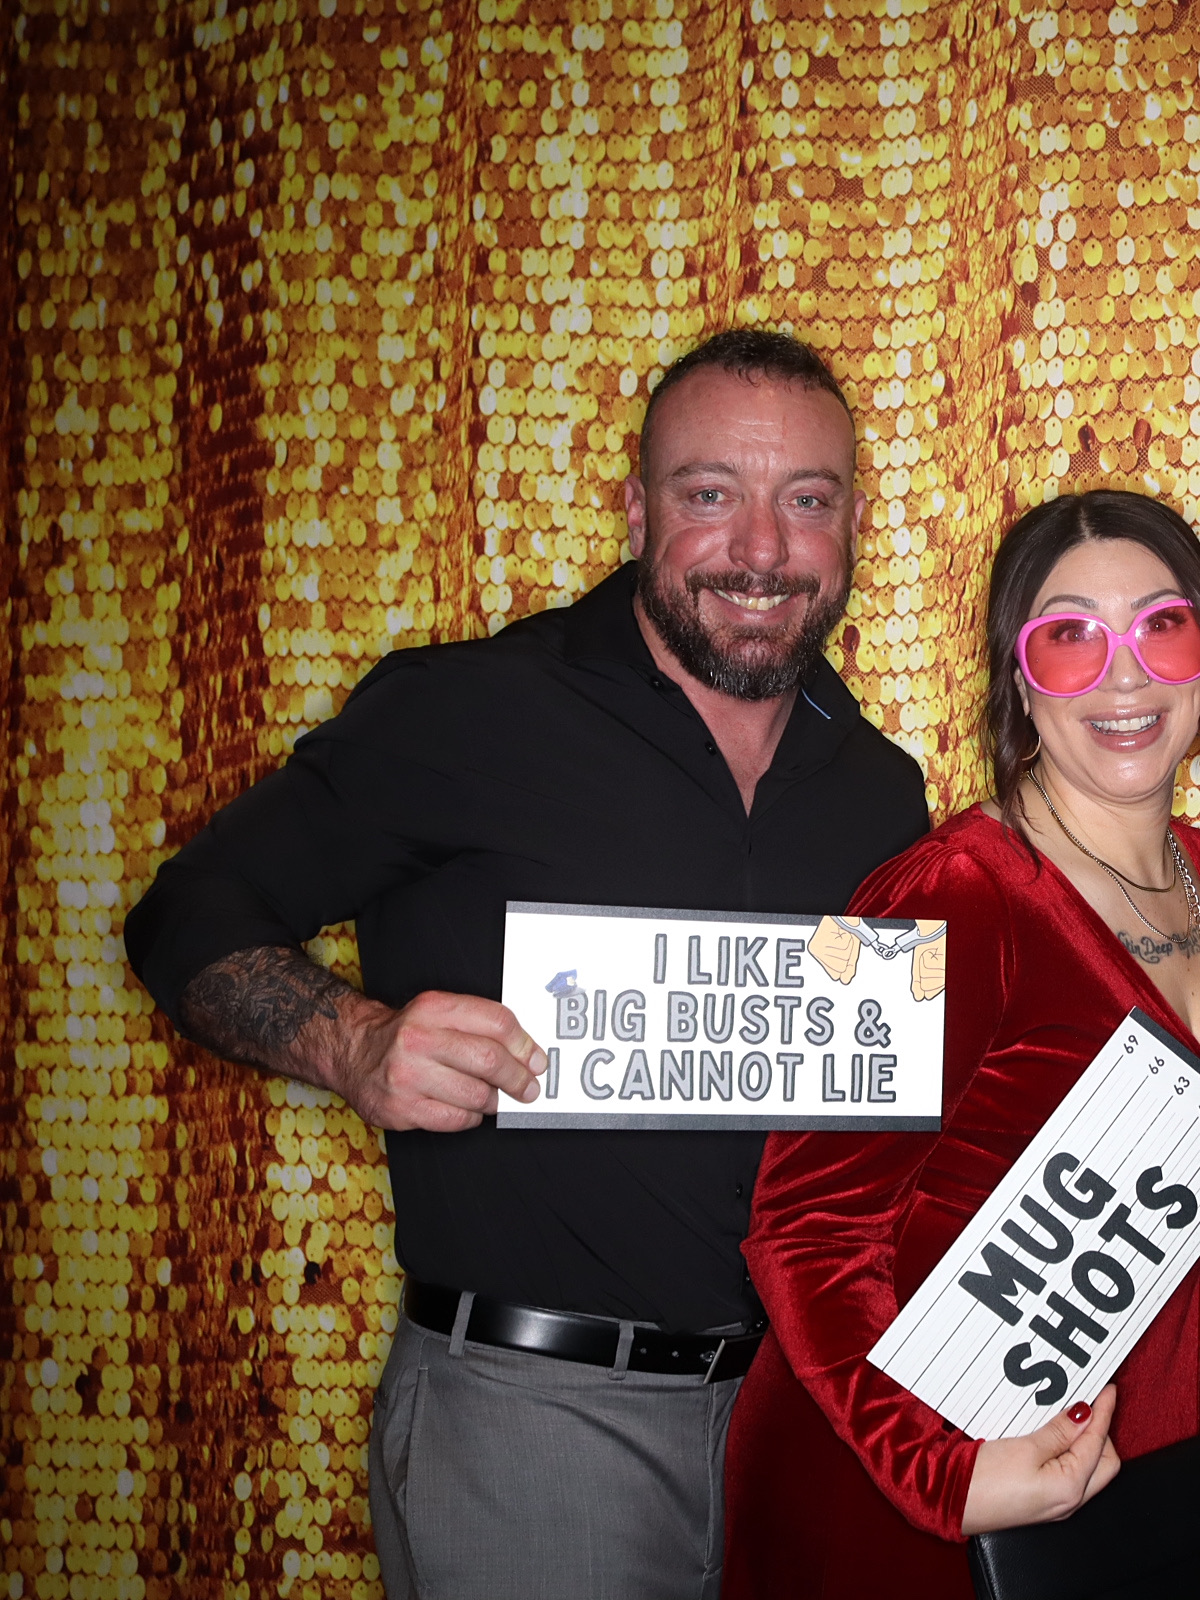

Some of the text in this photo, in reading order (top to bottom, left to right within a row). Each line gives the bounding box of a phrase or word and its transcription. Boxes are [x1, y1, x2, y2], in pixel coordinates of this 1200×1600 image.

[653, 933, 805, 988] I LIKE
[1141, 936, 1173, 956] Deep
[556, 989, 892, 1048] BIG BUSTS &
[1123, 1034, 1139, 1054] 69
[545, 1047, 897, 1102] I CANNOT LIE
[1148, 1056, 1165, 1075] 66
[1173, 1076, 1190, 1096] 63
[957, 1152, 1117, 1326] MUG
[1003, 1165, 1198, 1406] SHOTS
